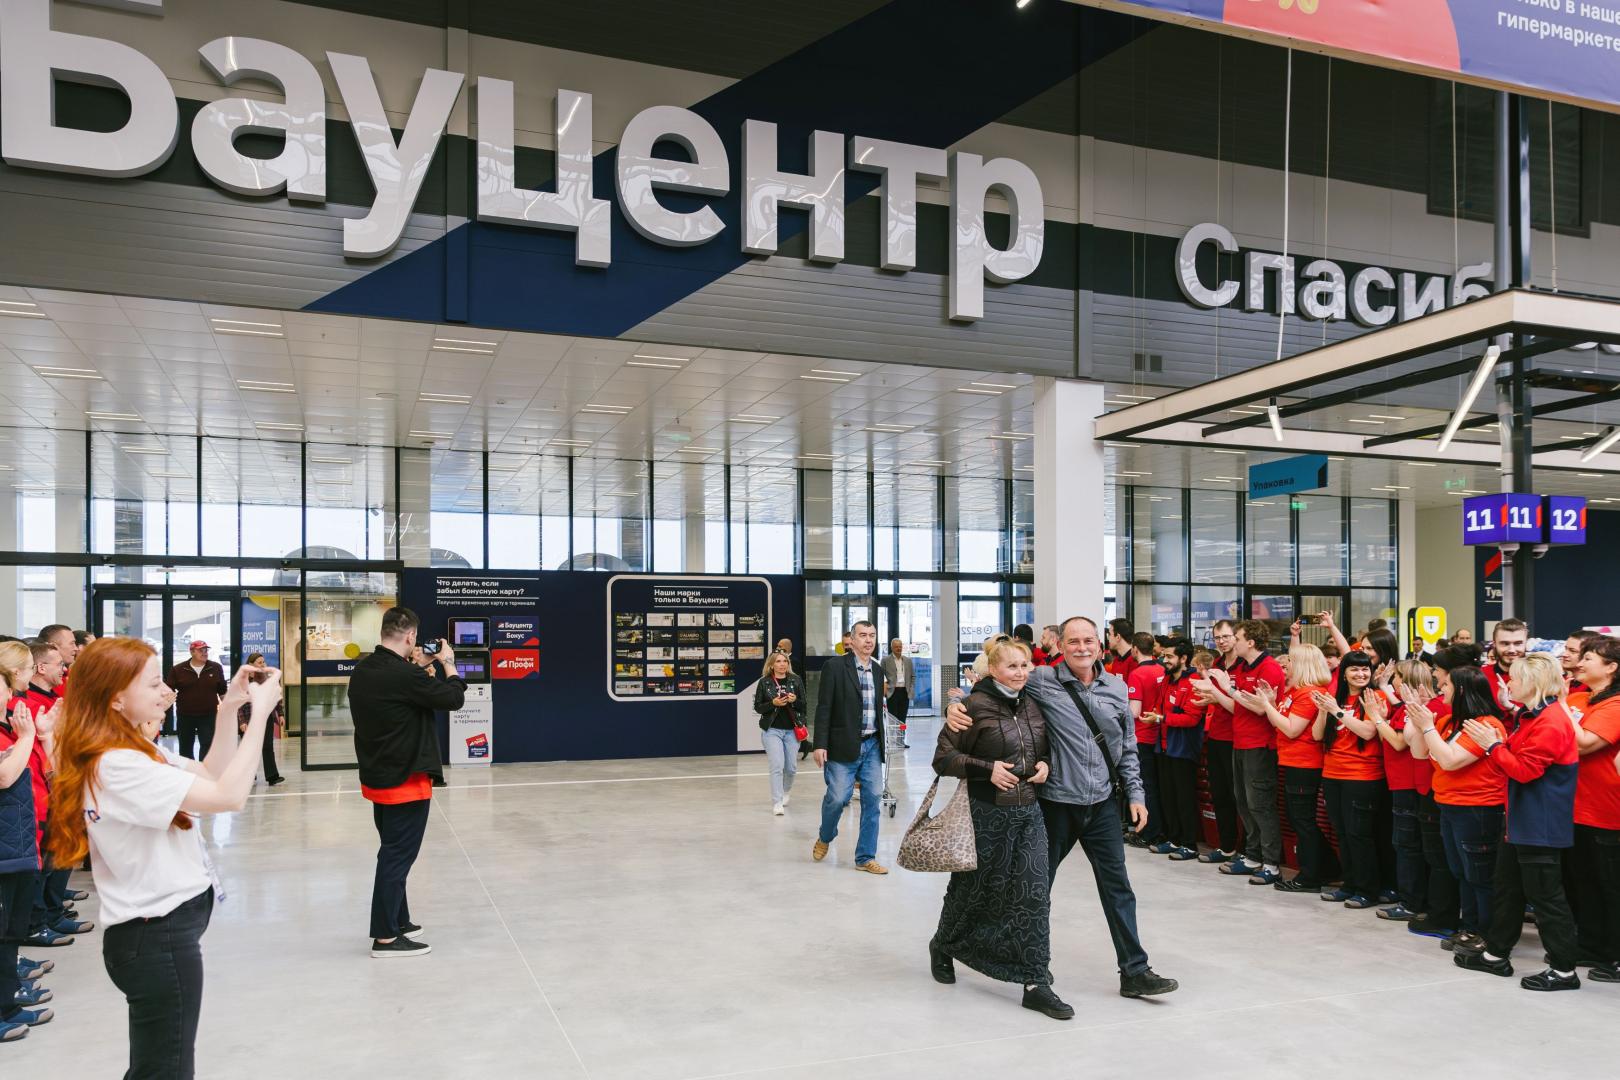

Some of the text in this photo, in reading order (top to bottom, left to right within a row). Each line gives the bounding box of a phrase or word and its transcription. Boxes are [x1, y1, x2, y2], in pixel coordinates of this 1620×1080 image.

[0, 0, 1045, 322] Бауцентр
[1175, 222, 1493, 326] Спасиб
[1253, 477, 1295, 491] Упаковка
[1466, 508, 1495, 532] 11
[1509, 506, 1533, 529] 11
[1552, 509, 1578, 531] 12
[436, 579, 451, 587] Что
[451, 580, 480, 588] делать,
[461, 587, 498, 596] бонусную
[499, 588, 525, 596] карту?
[653, 588, 701, 598] Наши марки
[1484, 586, 1504, 599] Туа
[688, 596, 729, 605] Бауцентре
[504, 622, 533, 630] Бауцентр
[242, 631, 264, 641] БОНУС
[242, 643, 277, 654] ОТКРЫТИЯ
[337, 663, 356, 671] Вых
[508, 660, 534, 670] Профи
